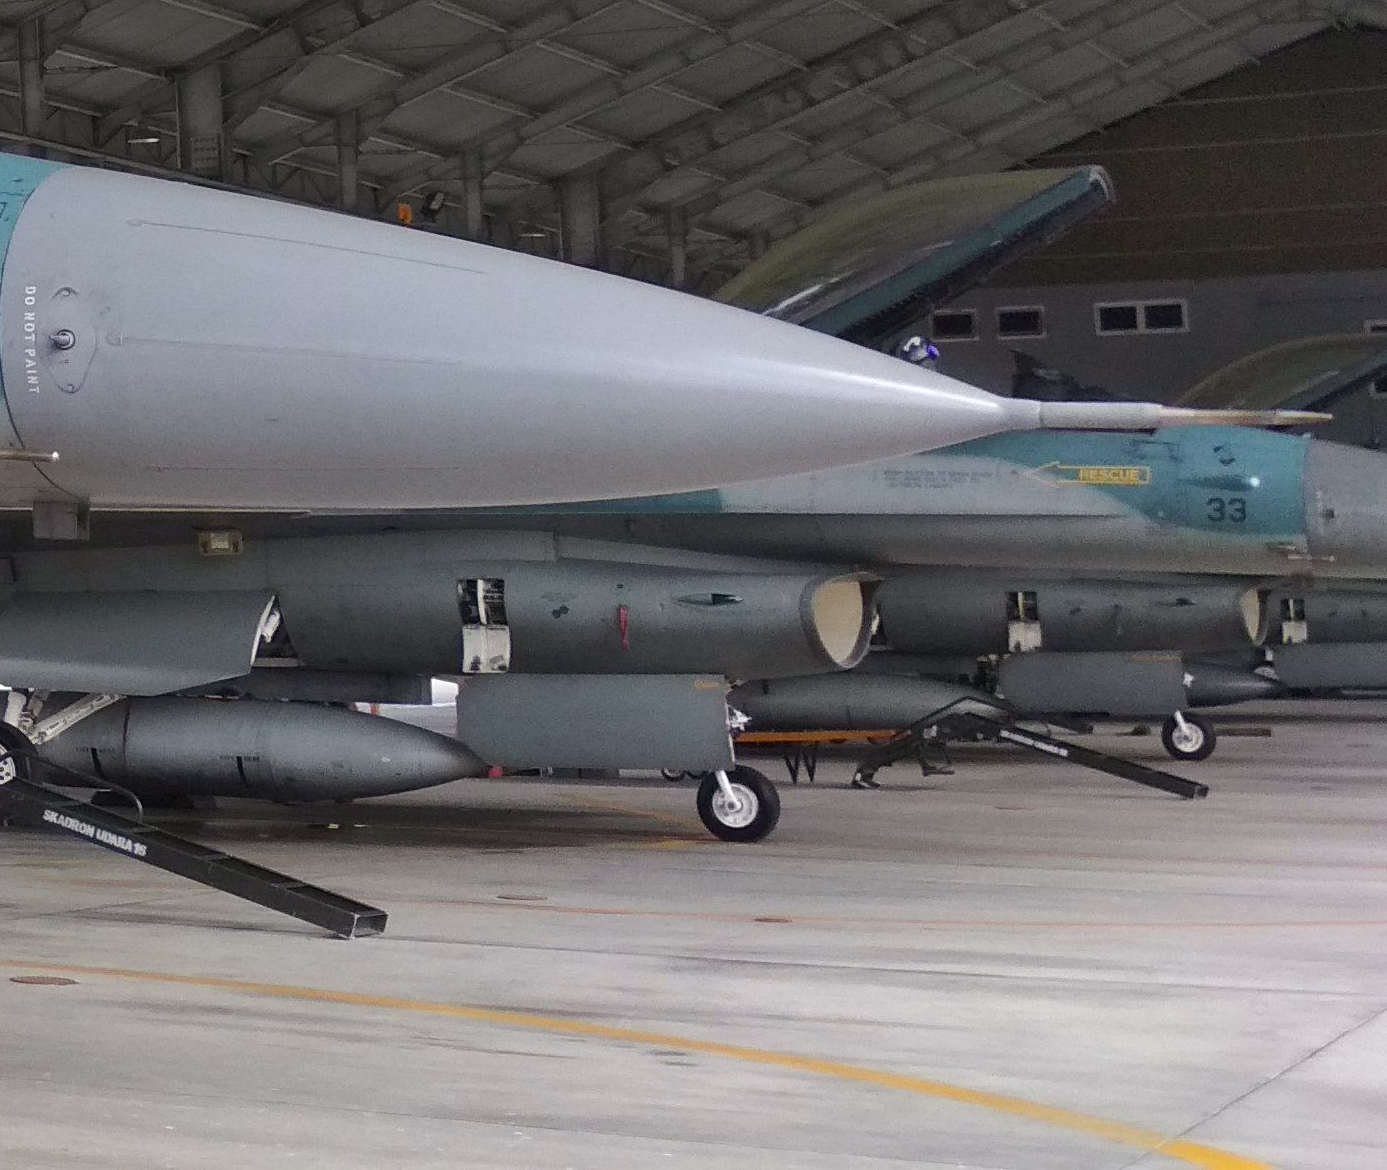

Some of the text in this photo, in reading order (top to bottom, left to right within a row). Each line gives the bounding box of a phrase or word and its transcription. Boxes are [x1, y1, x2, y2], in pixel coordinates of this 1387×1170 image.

[23, 285, 40, 394] DO NOT PAINT
[1080, 469, 1141, 483] RESCUE
[1206, 497, 1247, 523] 33
[43, 809, 95, 838] SKADRON
[96, 828, 133, 852] UDARA
